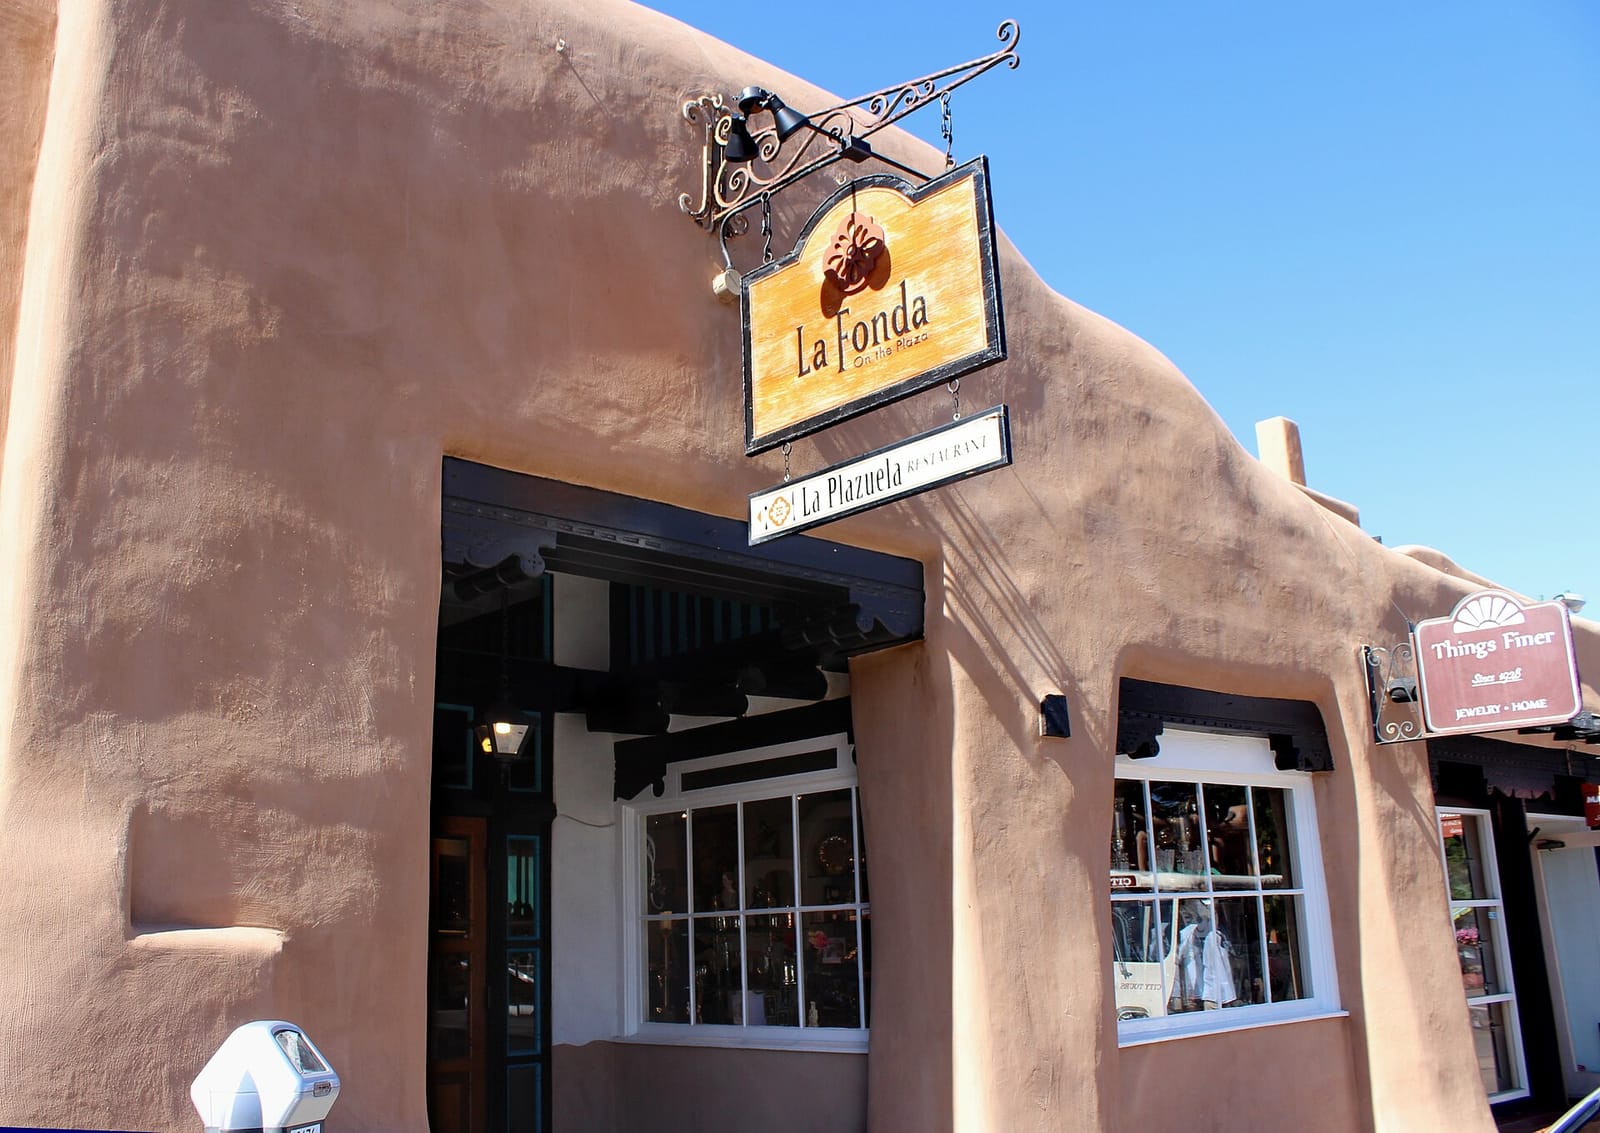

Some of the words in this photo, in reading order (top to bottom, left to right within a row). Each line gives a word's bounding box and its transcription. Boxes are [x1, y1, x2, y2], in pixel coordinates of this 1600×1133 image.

[796, 324, 828, 378] La
[836, 279, 929, 374] Fonda
[854, 355, 871, 368] On
[875, 346, 893, 360] the
[896, 332, 928, 352] Plaza
[802, 486, 821, 517] La
[828, 458, 903, 507] Plazuela
[907, 434, 987, 473] RESTAURANT
[1431, 639, 1497, 660] Things
[1502, 631, 1556, 650] Finer
[1471, 672, 1496, 685] Since
[1498, 667, 1522, 684] 1928
[1455, 703, 1501, 720] JEWELRY
[1511, 699, 1548, 712] HOME
